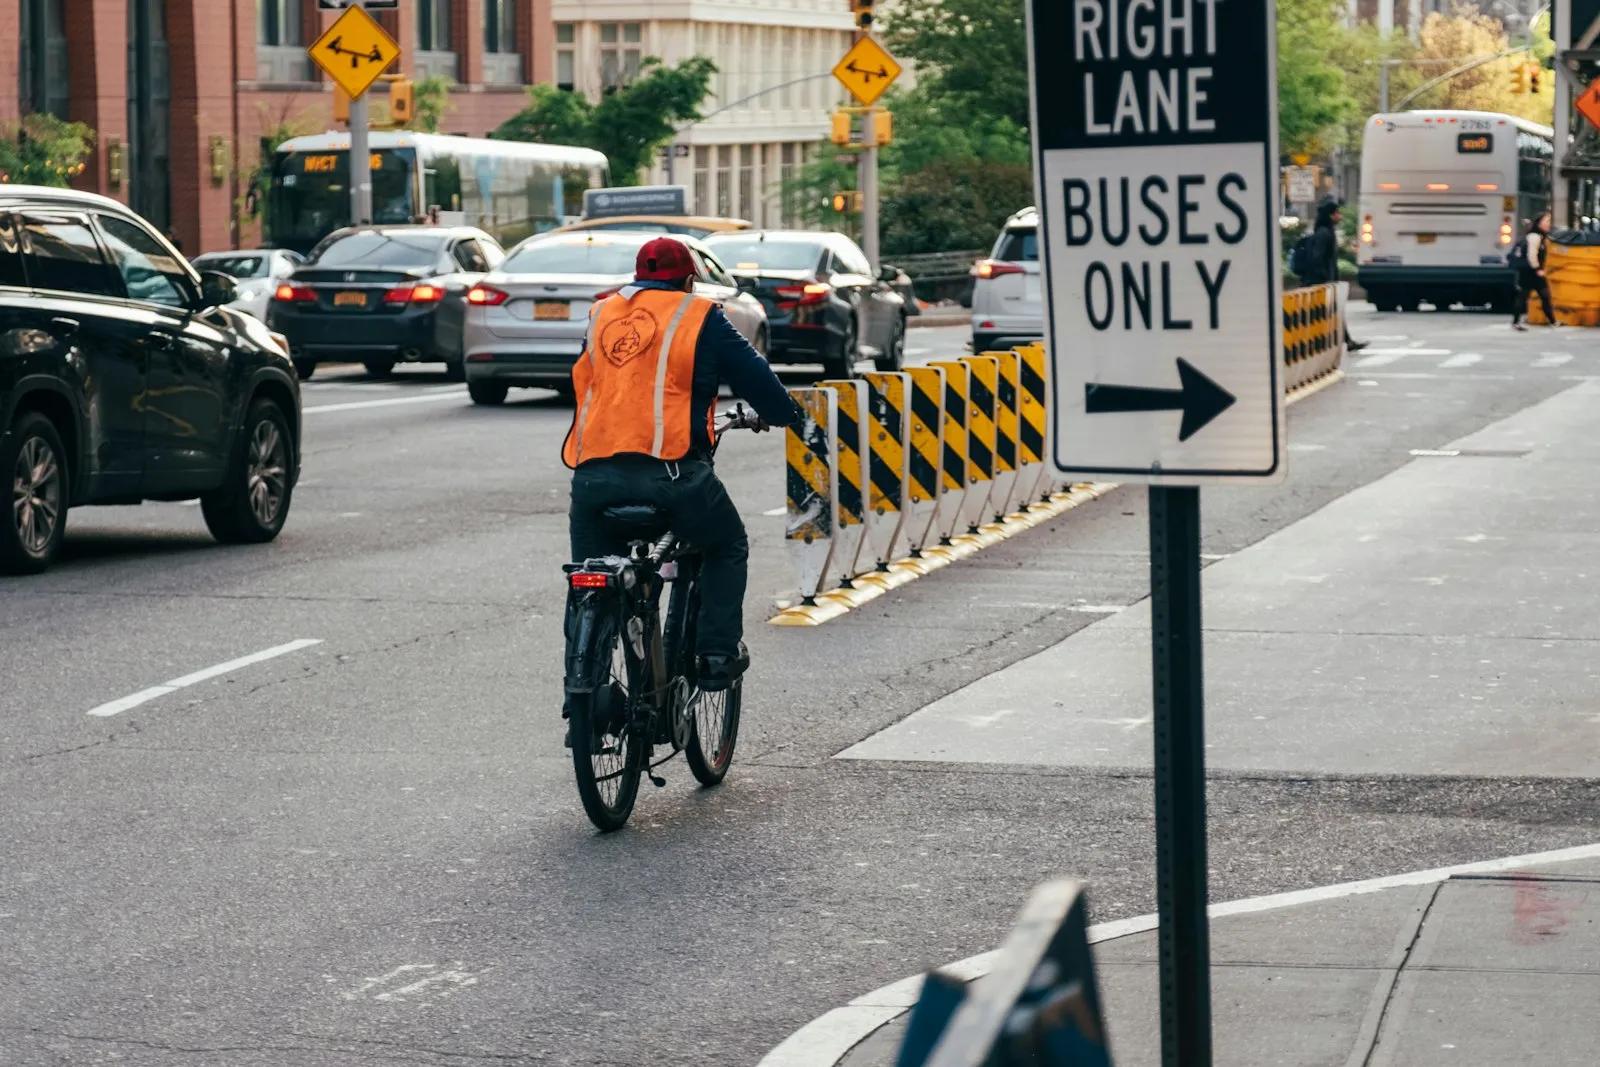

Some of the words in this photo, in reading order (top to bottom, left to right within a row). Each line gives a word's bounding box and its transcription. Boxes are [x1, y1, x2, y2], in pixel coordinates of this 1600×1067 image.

[1074, 0, 1223, 60] RIGHT
[1084, 66, 1216, 135] LANE
[1063, 172, 1248, 247] BUSES
[1084, 260, 1231, 331] ONLY
